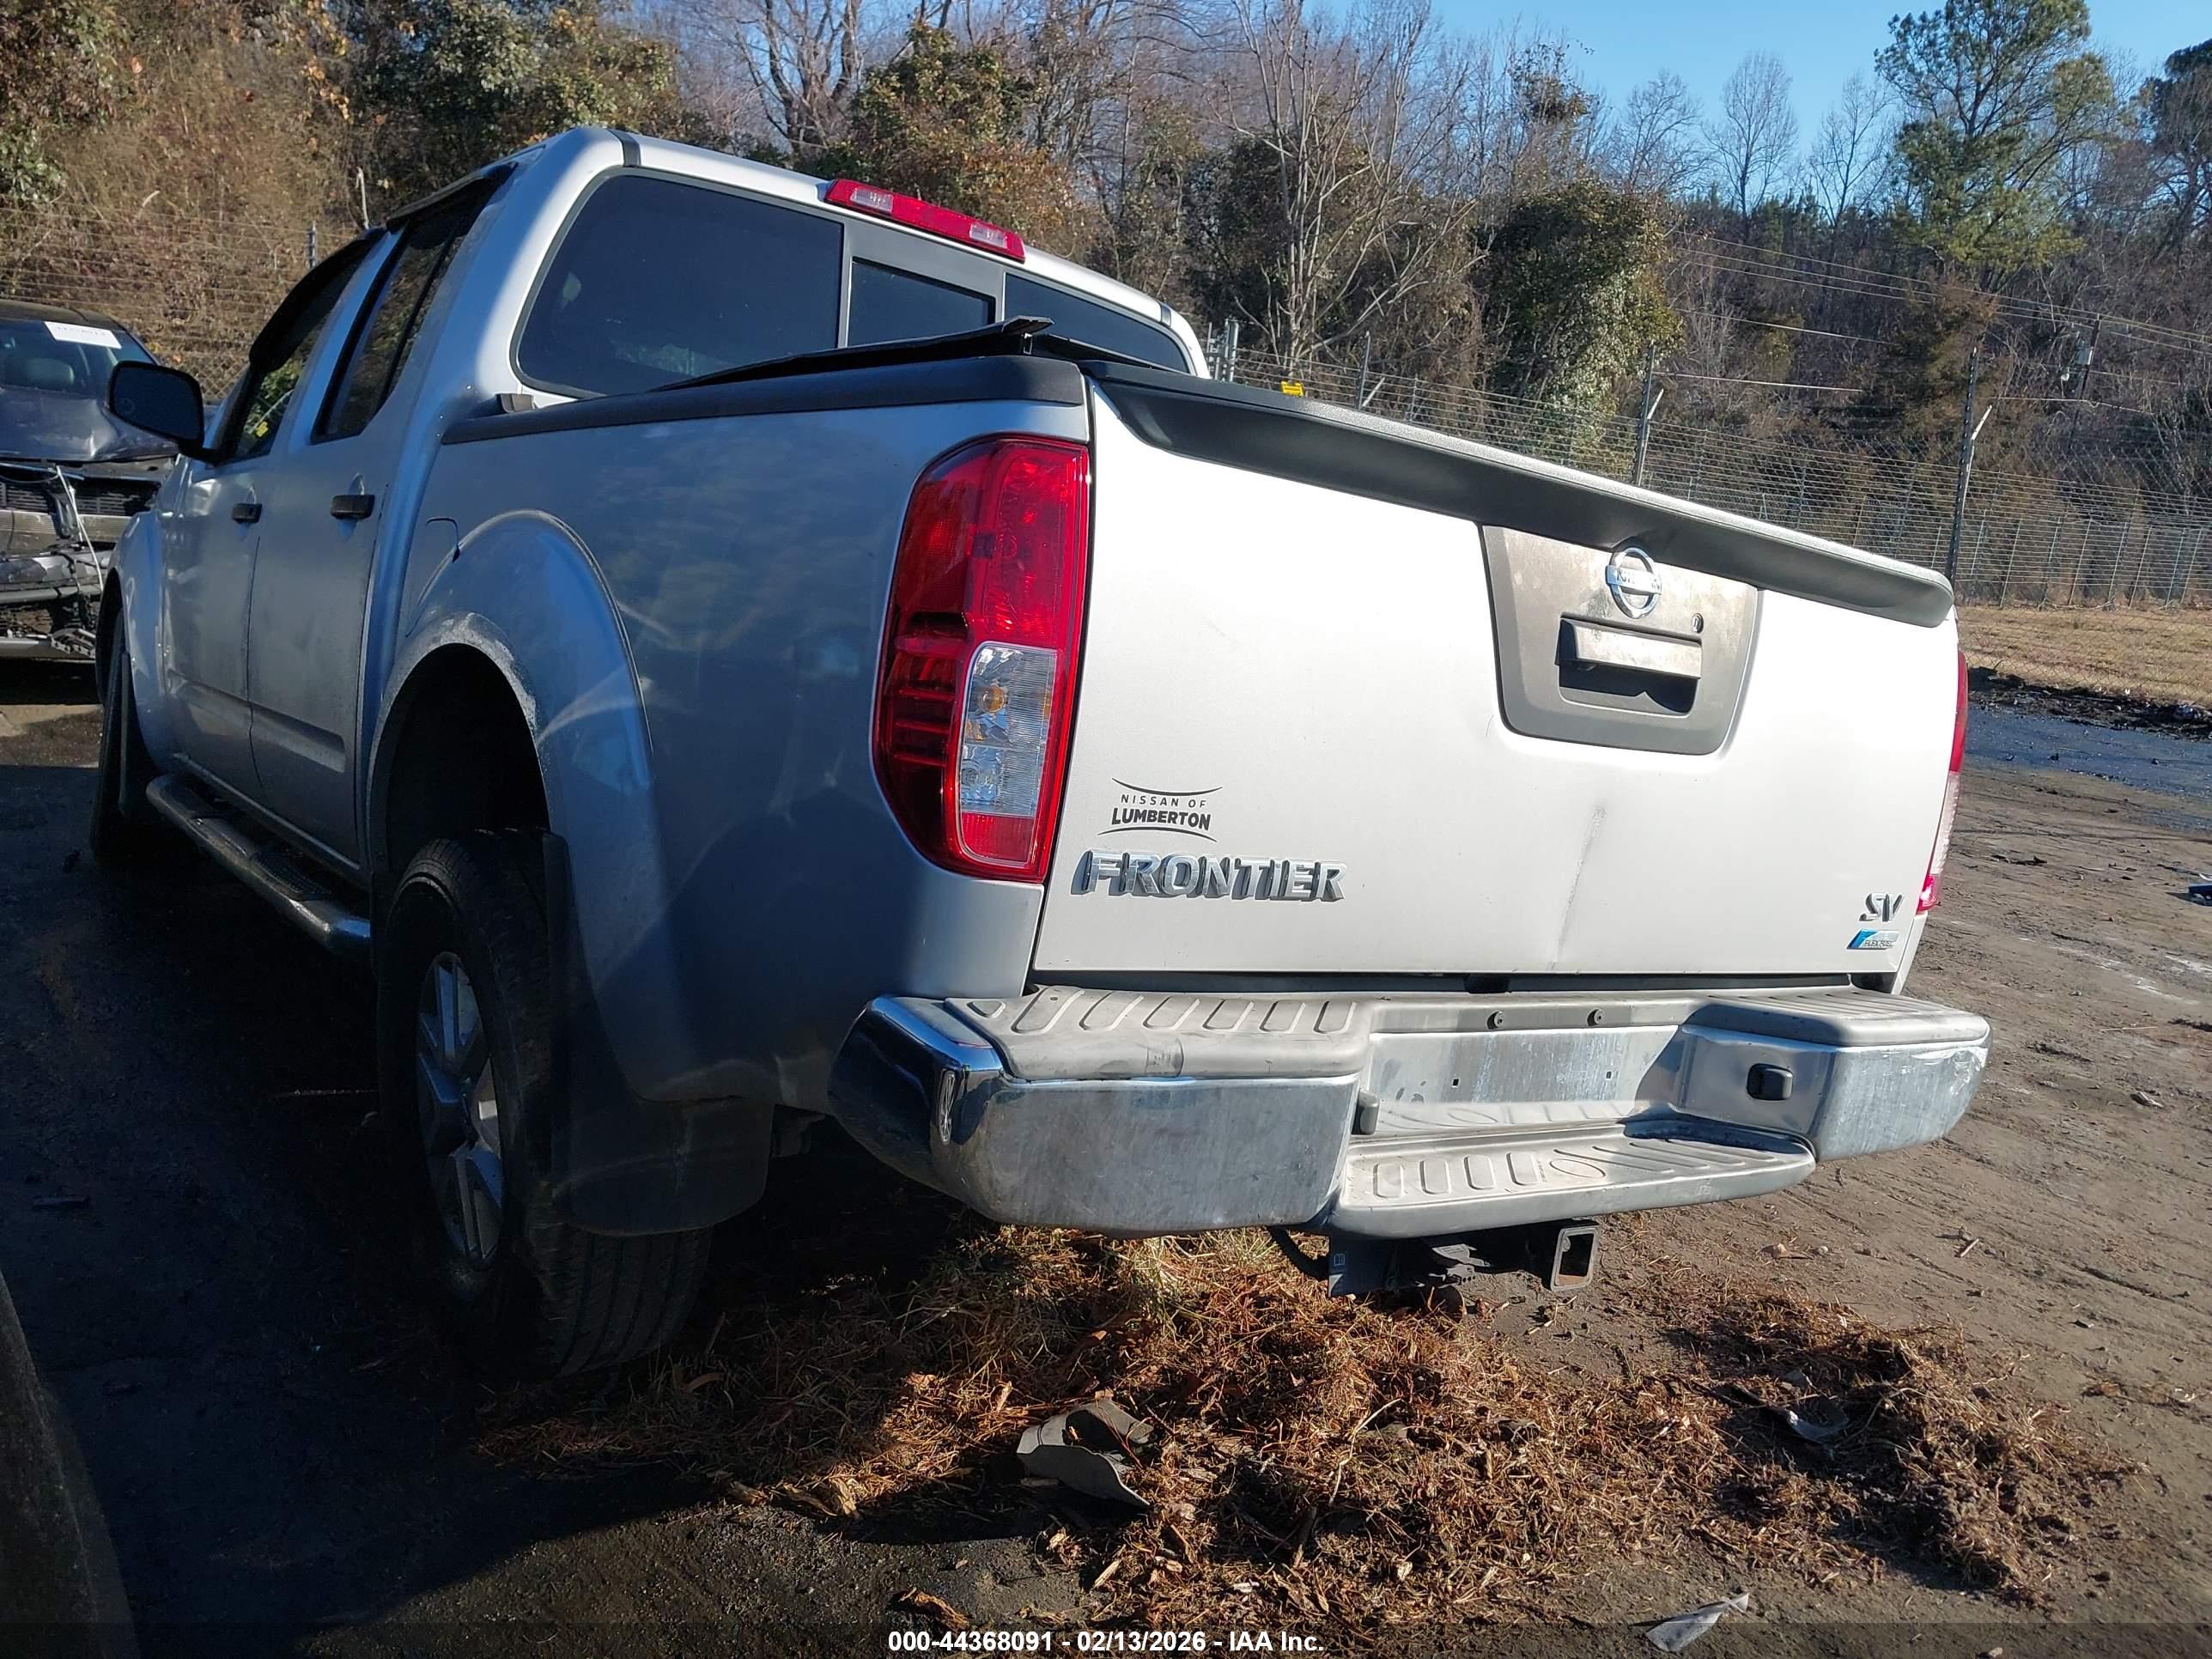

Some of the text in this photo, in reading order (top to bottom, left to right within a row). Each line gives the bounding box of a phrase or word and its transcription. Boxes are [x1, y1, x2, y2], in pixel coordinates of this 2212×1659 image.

[1121, 793, 1206, 808] NISSAN OF
[1111, 807, 1212, 831] LUMBERTON
[1071, 848, 1348, 902] FRONTIER
[1858, 893, 1904, 922] SV
